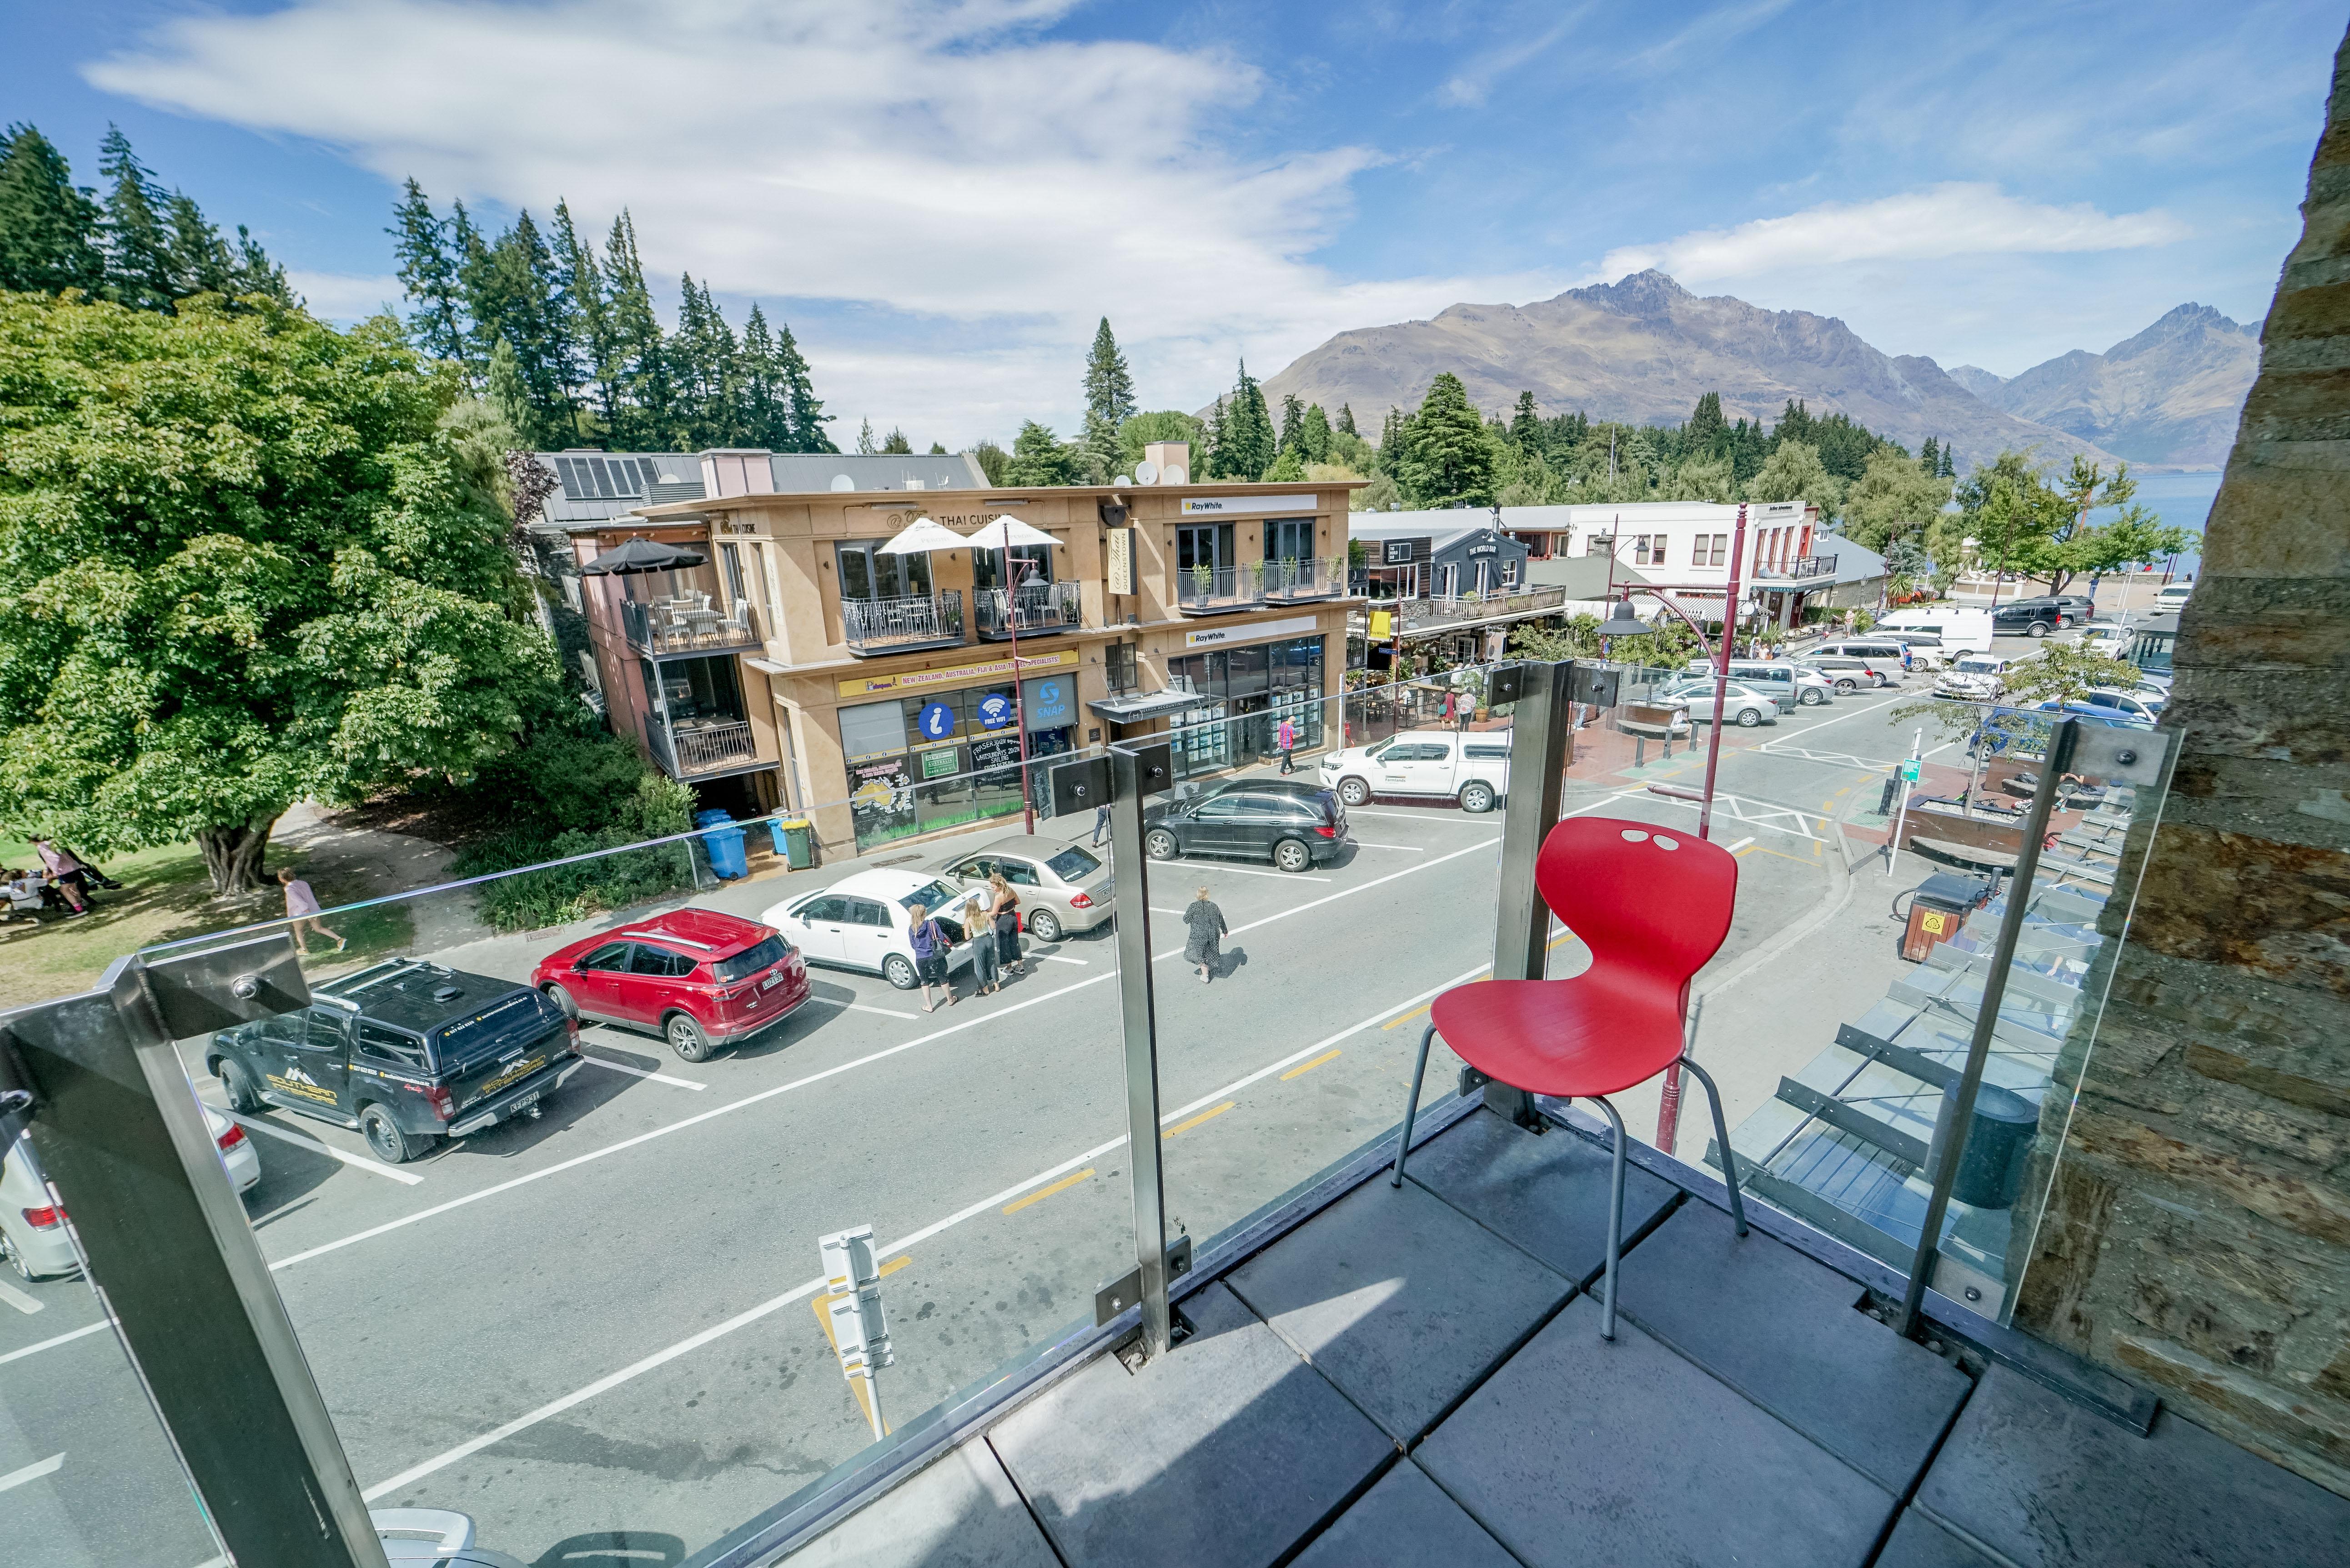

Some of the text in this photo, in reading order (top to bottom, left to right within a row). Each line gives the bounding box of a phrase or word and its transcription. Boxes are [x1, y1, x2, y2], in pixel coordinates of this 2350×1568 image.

[939, 515, 966, 526] THAI
[1477, 545, 1489, 553] WORLD
[918, 673, 944, 682] ZEALAND,
[946, 668, 976, 678] AUSTRALIA,
[1008, 661, 1026, 670] TRVEL
[1037, 704, 1065, 718] SNAP
[1157, 702, 1184, 710] ACCOUNTING
[973, 740, 994, 755] FRASER
[975, 749, 1007, 761] WHITSUNDAYS
[991, 755, 1009, 764] SAILING
[482, 1054, 546, 1091] SOUTHERN
[484, 1060, 545, 1094] INTERIORS
[266, 1074, 337, 1099] SOUTHERN
[271, 1082, 337, 1106] INTERIORS
[511, 1092, 539, 1111] KFP931
